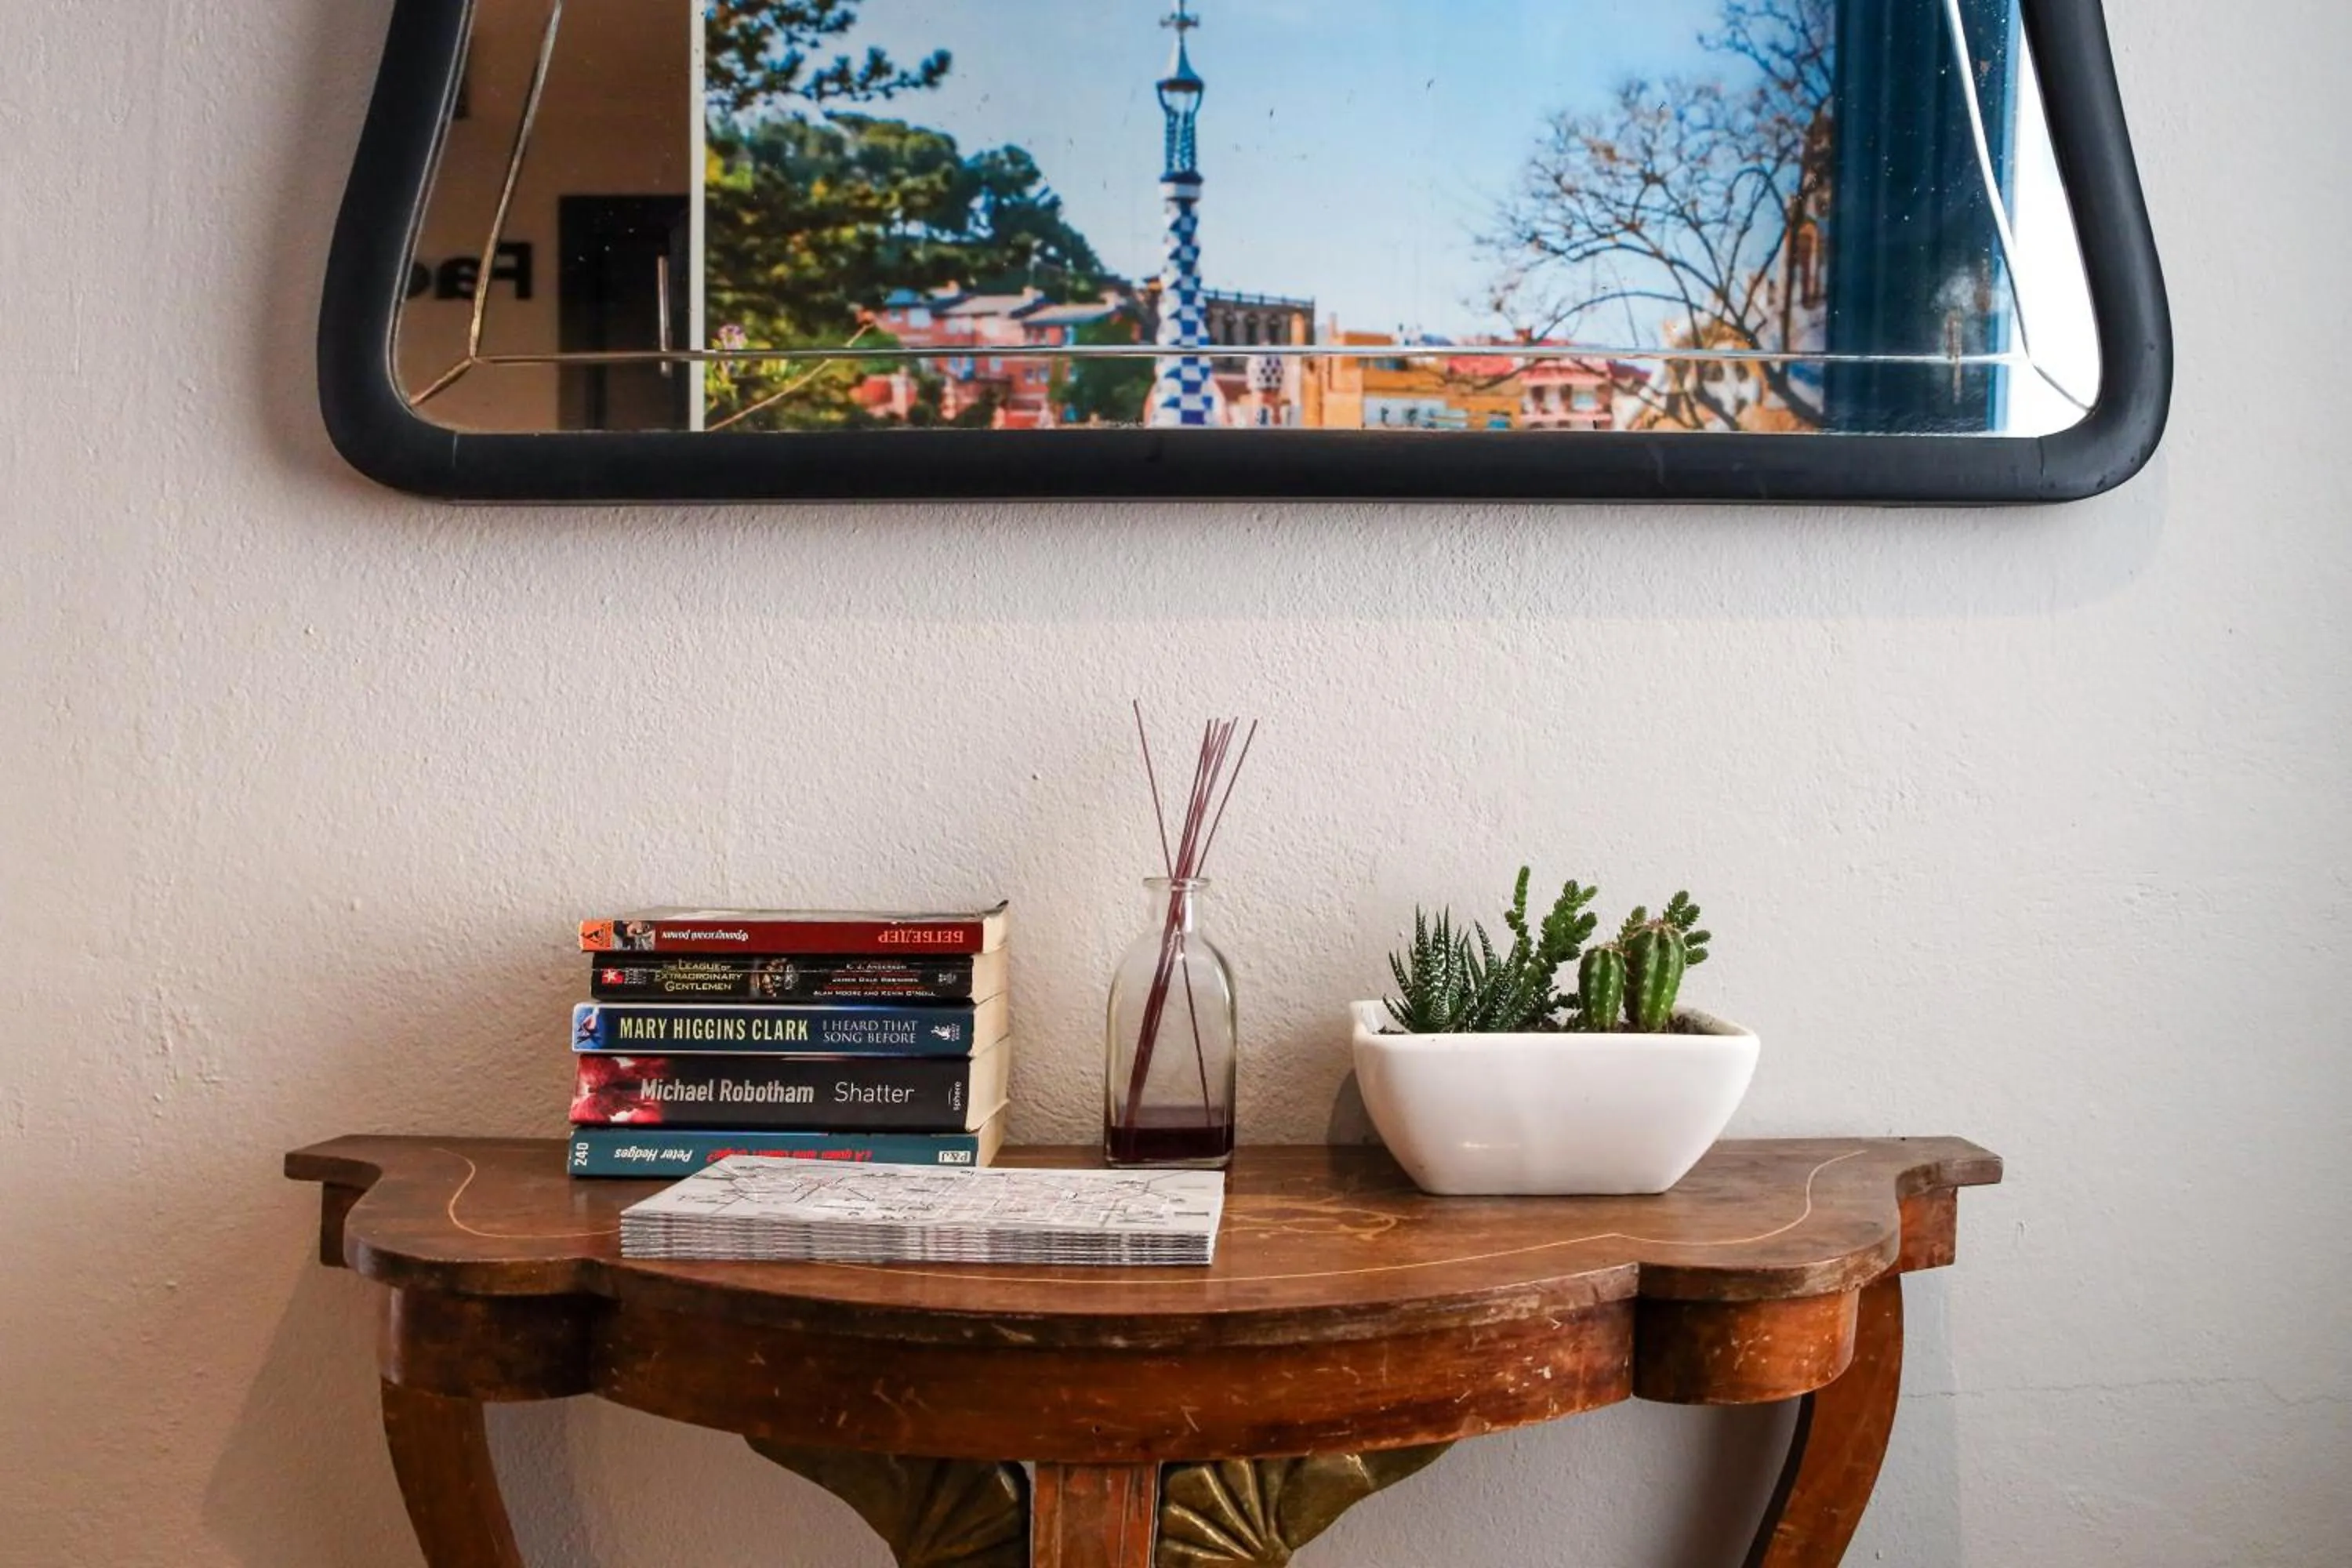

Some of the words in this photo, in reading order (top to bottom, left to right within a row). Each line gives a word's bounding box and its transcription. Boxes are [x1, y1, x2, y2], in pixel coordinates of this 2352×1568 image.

[877, 929, 964, 944] БЕГБЕДЕР
[677, 959, 721, 971] LEAGUE
[655, 972, 743, 982] EXTRAORDINARY
[665, 982, 732, 992] GENTLEMEN
[619, 1017, 668, 1040] MARY
[673, 1018, 746, 1040] HIGGINS
[752, 1018, 808, 1041] CLARK
[823, 1020, 827, 1031] I
[831, 1020, 880, 1031] HEARD
[883, 1020, 918, 1032] THAT
[822, 1032, 863, 1044] SONG
[867, 1033, 917, 1044] BEFORE
[640, 1078, 713, 1102] Michael
[719, 1079, 815, 1103] Robotham
[833, 1081, 916, 1104] Shatter
[574, 1142, 588, 1167] 240
[613, 1145, 658, 1162] Hedges
[660, 1148, 694, 1163] Peter
